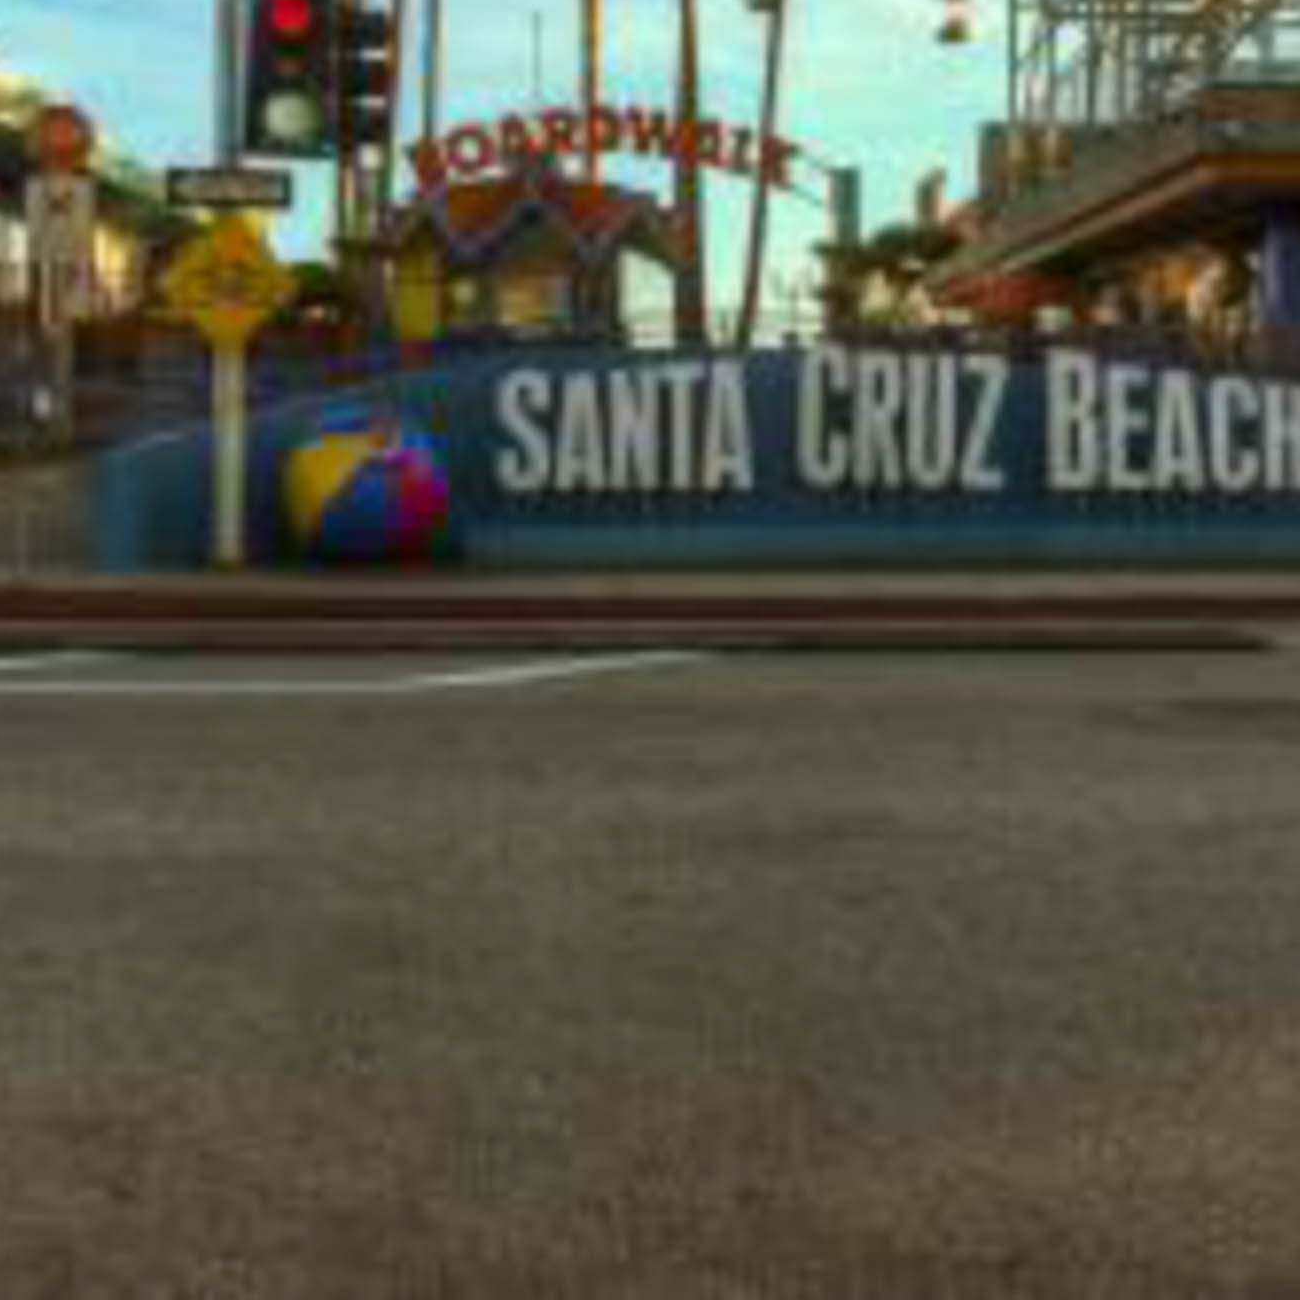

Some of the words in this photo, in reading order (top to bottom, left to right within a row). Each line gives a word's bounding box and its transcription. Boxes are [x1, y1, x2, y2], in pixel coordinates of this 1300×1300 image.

[404, 104, 804, 196] BOARDWALK
[497, 362, 754, 490] SANTA
[795, 343, 1007, 490] CRUZ
